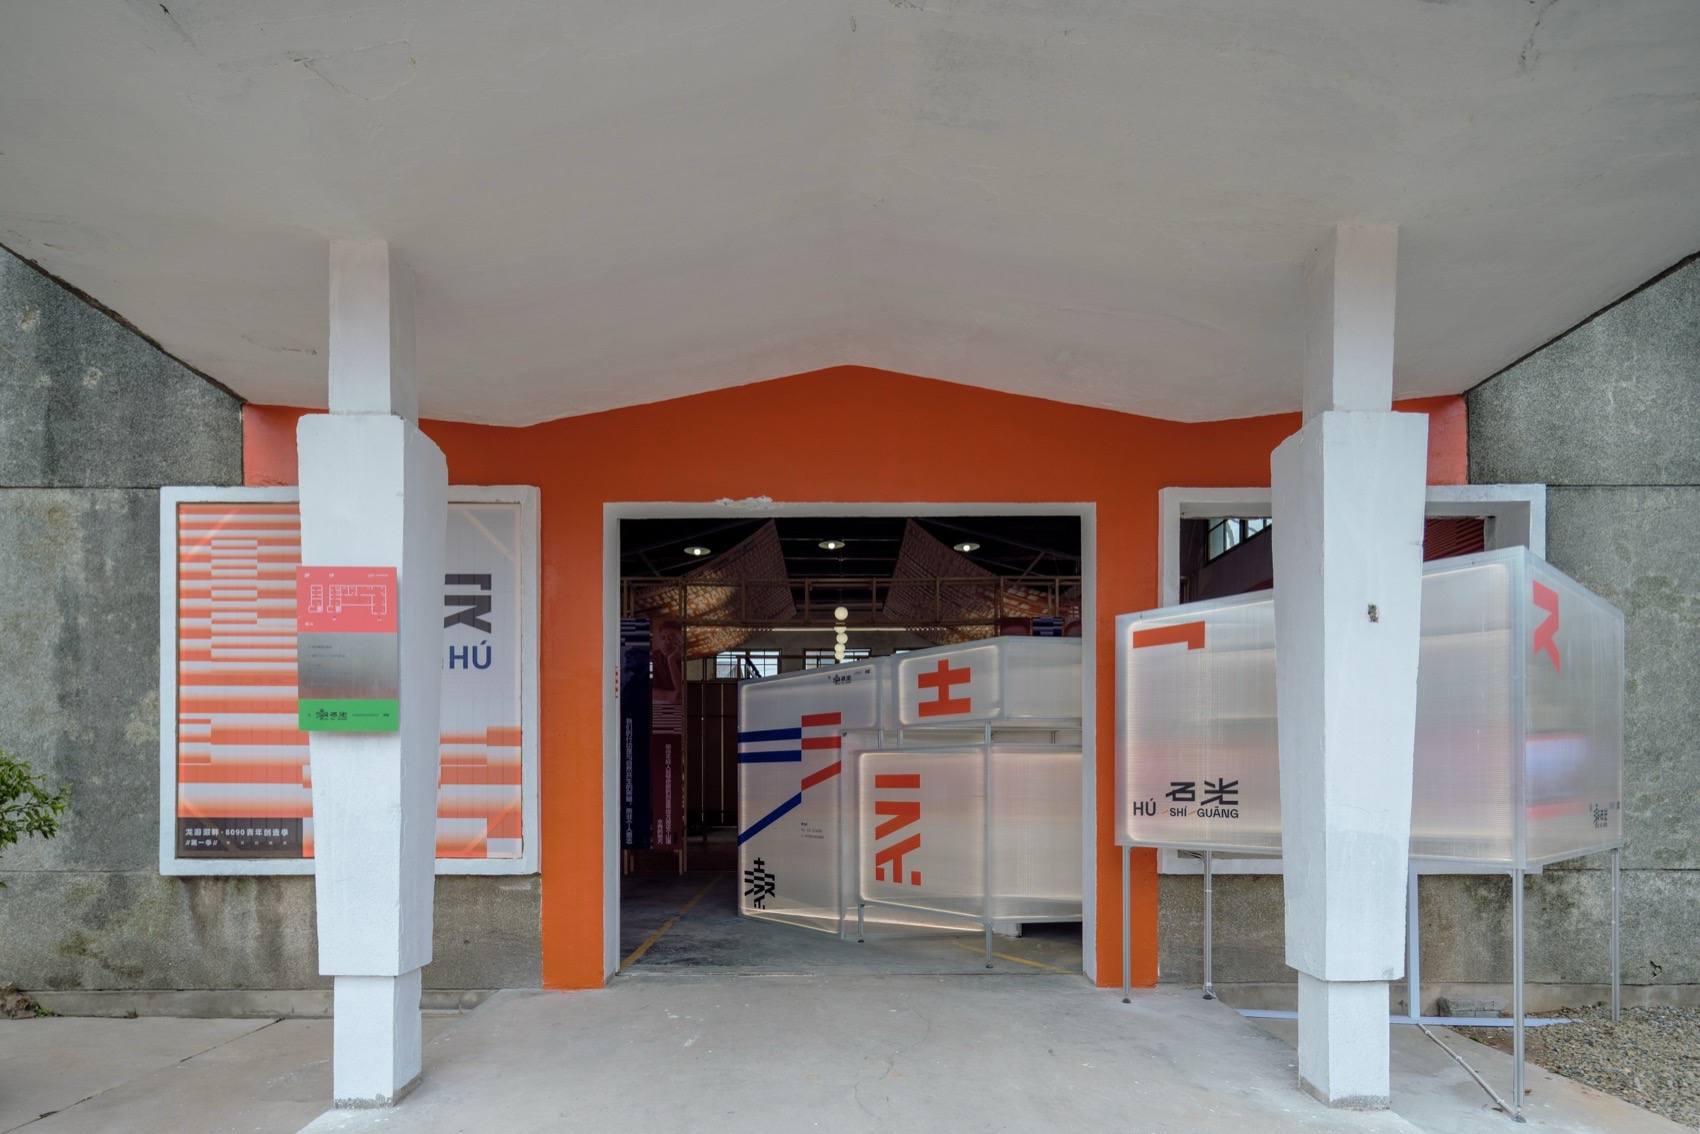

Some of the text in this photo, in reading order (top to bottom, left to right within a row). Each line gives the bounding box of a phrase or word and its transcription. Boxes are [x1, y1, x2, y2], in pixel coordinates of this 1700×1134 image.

[449, 640, 492, 670] HÚ
[1133, 798, 1239, 819] HÚ SHÍ GUĀNG
